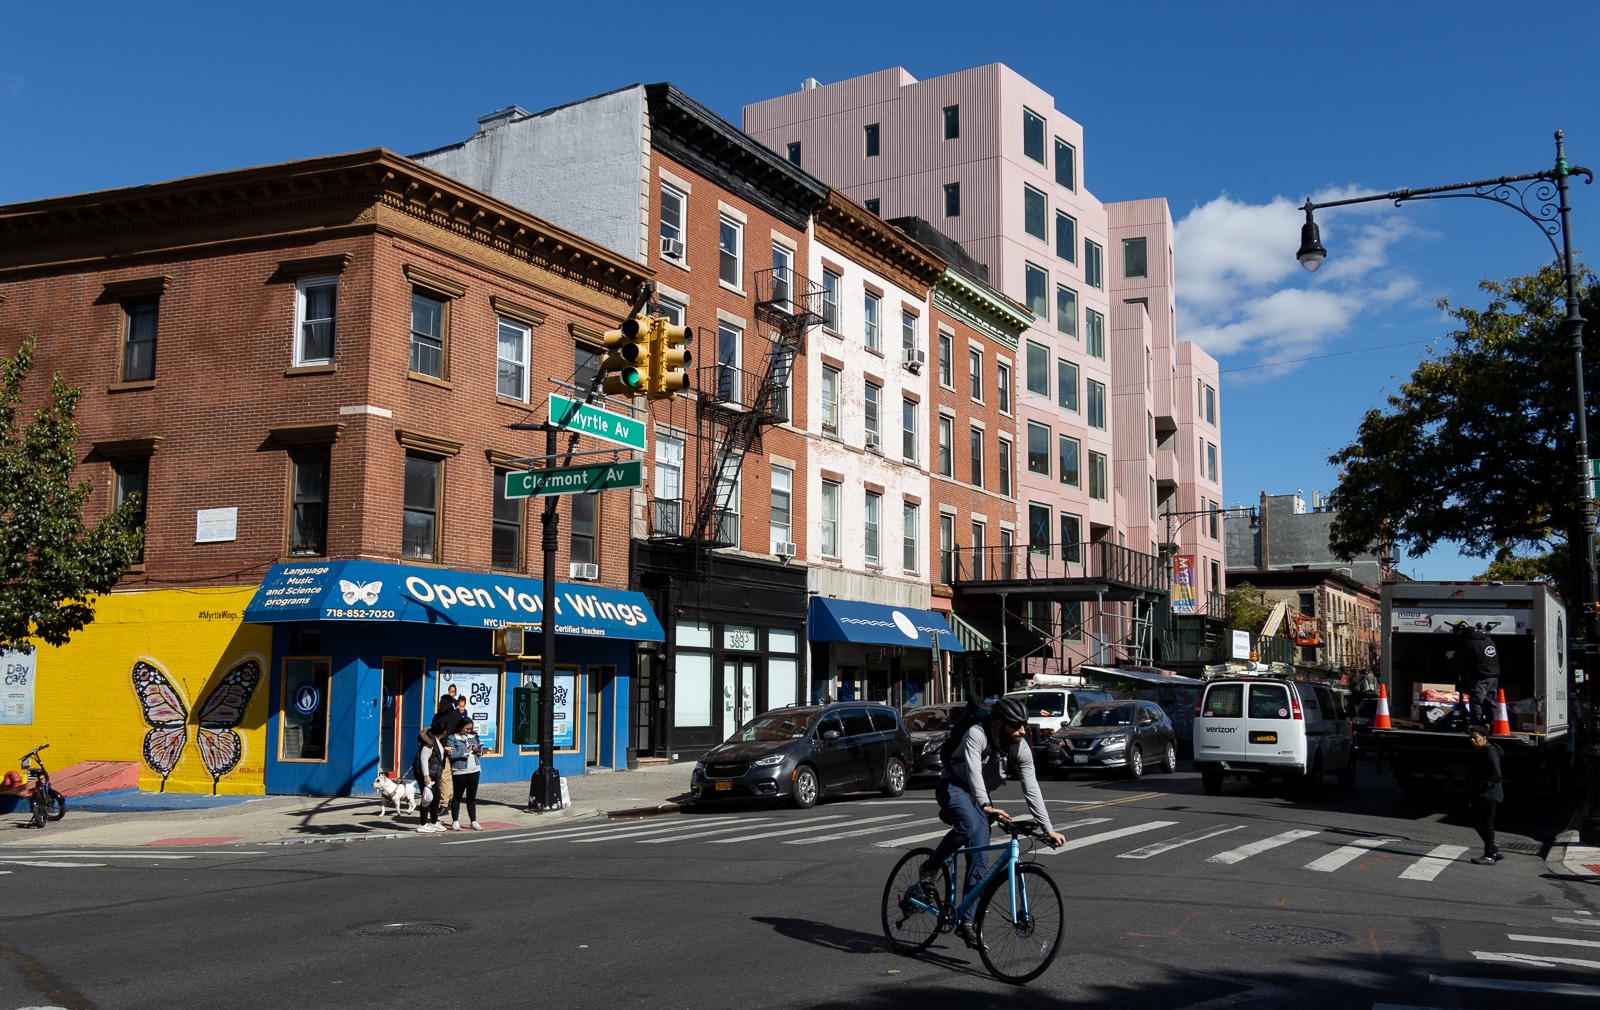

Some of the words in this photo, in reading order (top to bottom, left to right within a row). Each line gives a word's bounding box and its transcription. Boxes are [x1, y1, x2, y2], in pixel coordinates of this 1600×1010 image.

[570, 407, 609, 432] Myrtle
[614, 421, 630, 438] Av
[522, 471, 588, 489] Clermont
[606, 468, 625, 482] Av
[283, 566, 329, 576] Language
[286, 577, 314, 585] Music
[266, 587, 285, 596] and
[286, 586, 322, 595] Science
[264, 597, 310, 607] programs
[405, 576, 496, 609] Open
[565, 592, 648, 627] Wings
[326, 608, 395, 618] 718-852-7020
[483, 618, 498, 627] NYC
[554, 624, 580, 634] Certified
[580, 627, 605, 636] Teachers
[7, 663, 29, 678] Day
[5, 672, 27, 685] Care
[471, 682, 492, 698] Day
[470, 691, 490, 706] Care
[553, 693, 567, 706] are
[1205, 725, 1236, 733] verizon
